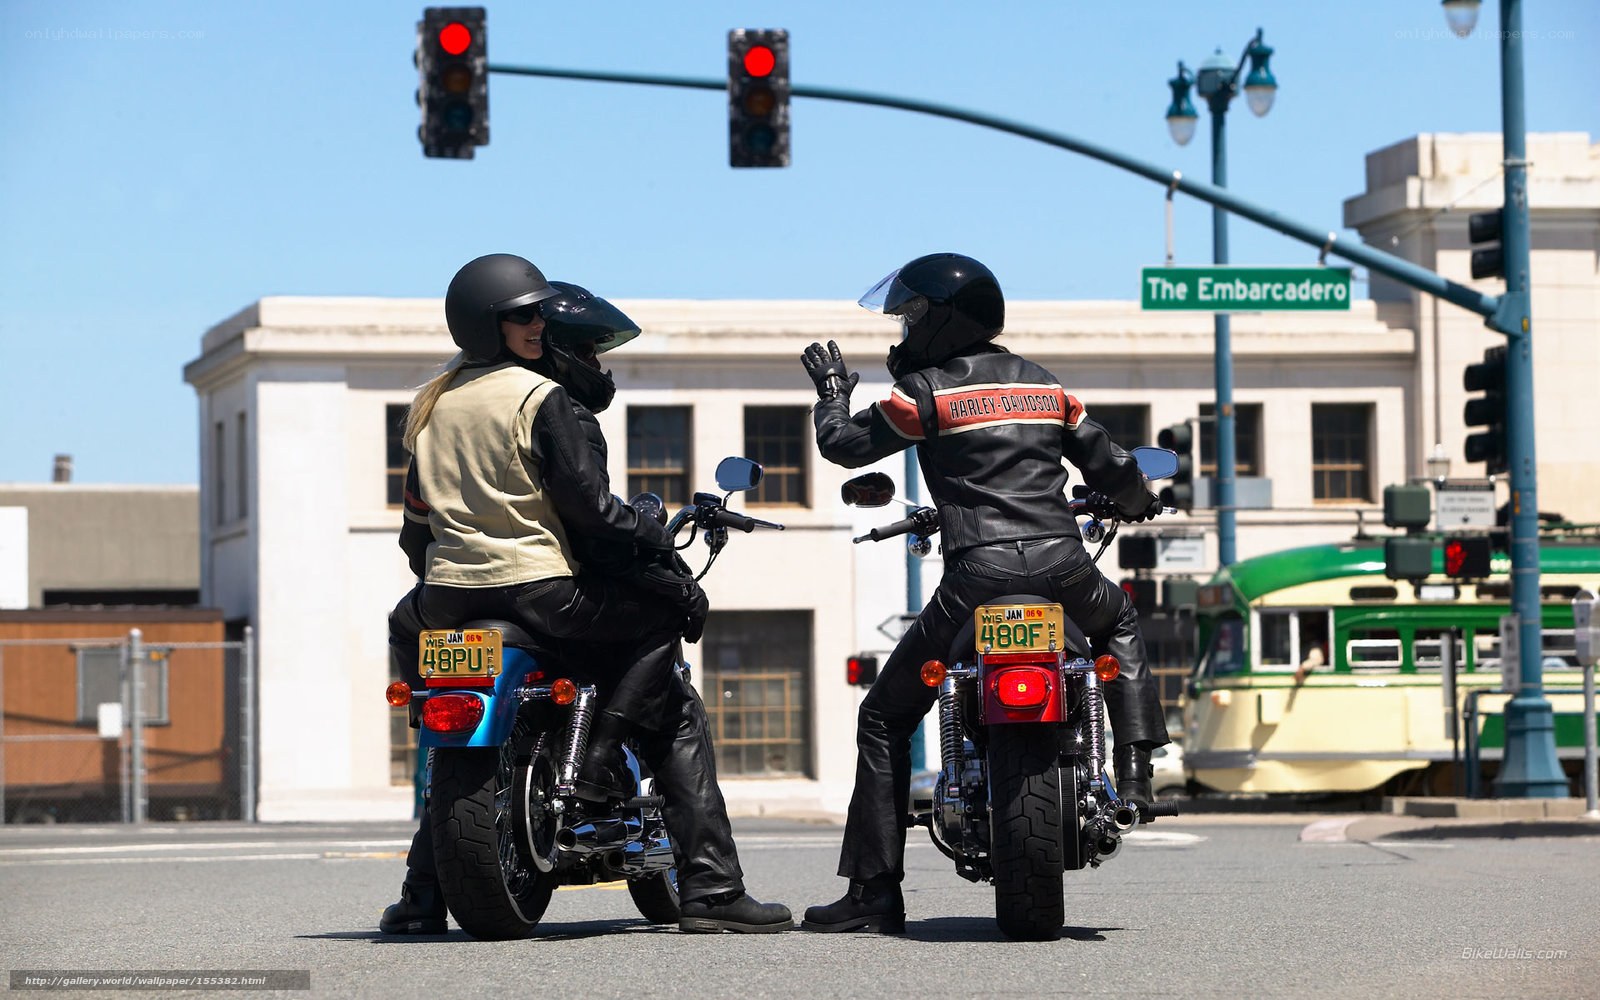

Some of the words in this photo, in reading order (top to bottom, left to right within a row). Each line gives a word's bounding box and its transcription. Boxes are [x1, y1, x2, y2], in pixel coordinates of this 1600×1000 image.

[1147, 277, 1188, 300] The
[1197, 277, 1347, 300] Embarcadero
[949, 394, 1060, 420] HARLEY-DAVIDSON
[981, 613, 1003, 624] WIS
[1006, 609, 1022, 620] JAN
[1026, 609, 1035, 617] 06
[425, 637, 445, 648] WIS
[447, 633, 463, 644] JAN
[466, 634, 475, 642] 06
[981, 623, 1044, 649] 48QF
[422, 647, 483, 673] 48PU
